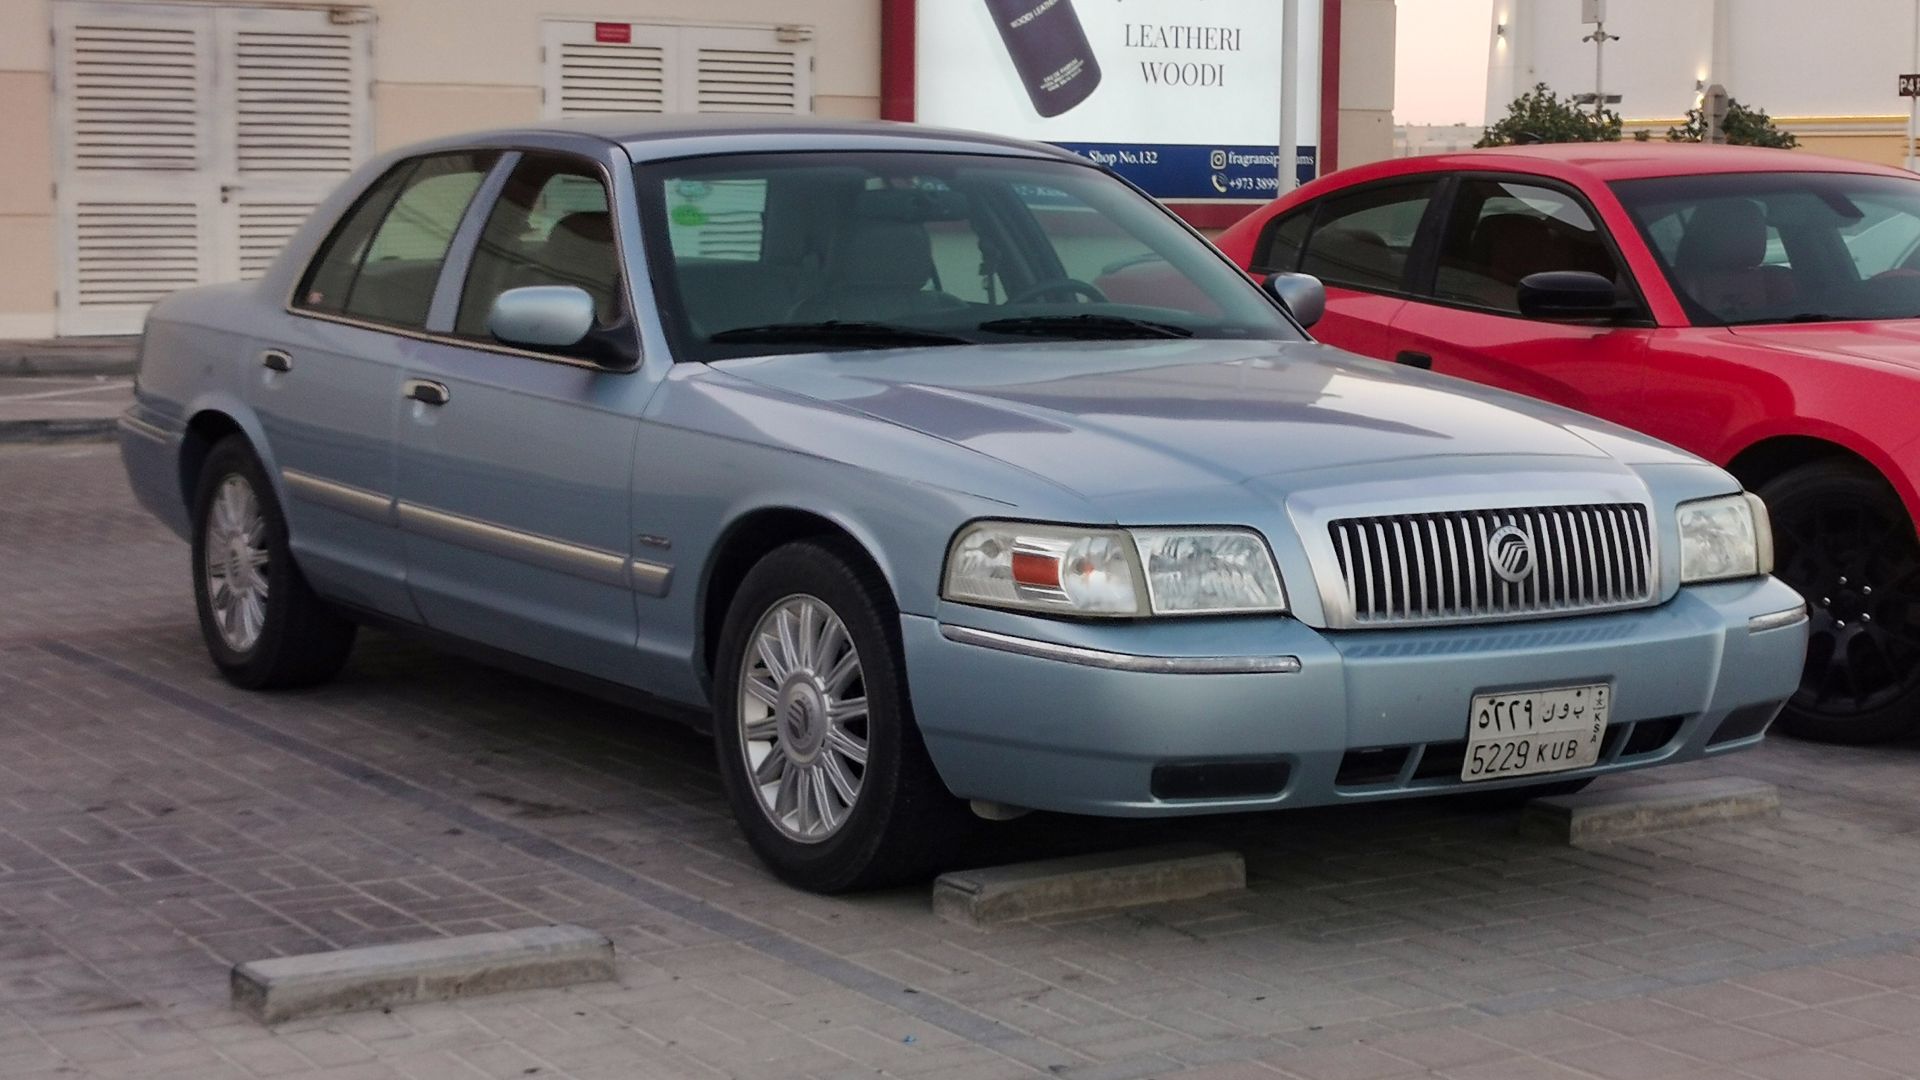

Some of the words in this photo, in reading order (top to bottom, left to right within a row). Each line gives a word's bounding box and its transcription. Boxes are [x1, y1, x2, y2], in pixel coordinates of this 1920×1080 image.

[1124, 23, 1241, 51] LEATHERI
[1140, 61, 1224, 87] WOODI
[1089, 150, 1117, 167] Shop
[1119, 150, 1158, 164] No.132
[1229, 177, 1254, 190] +973
[1471, 740, 1530, 775] 5229
[1537, 740, 1578, 763] KUB
